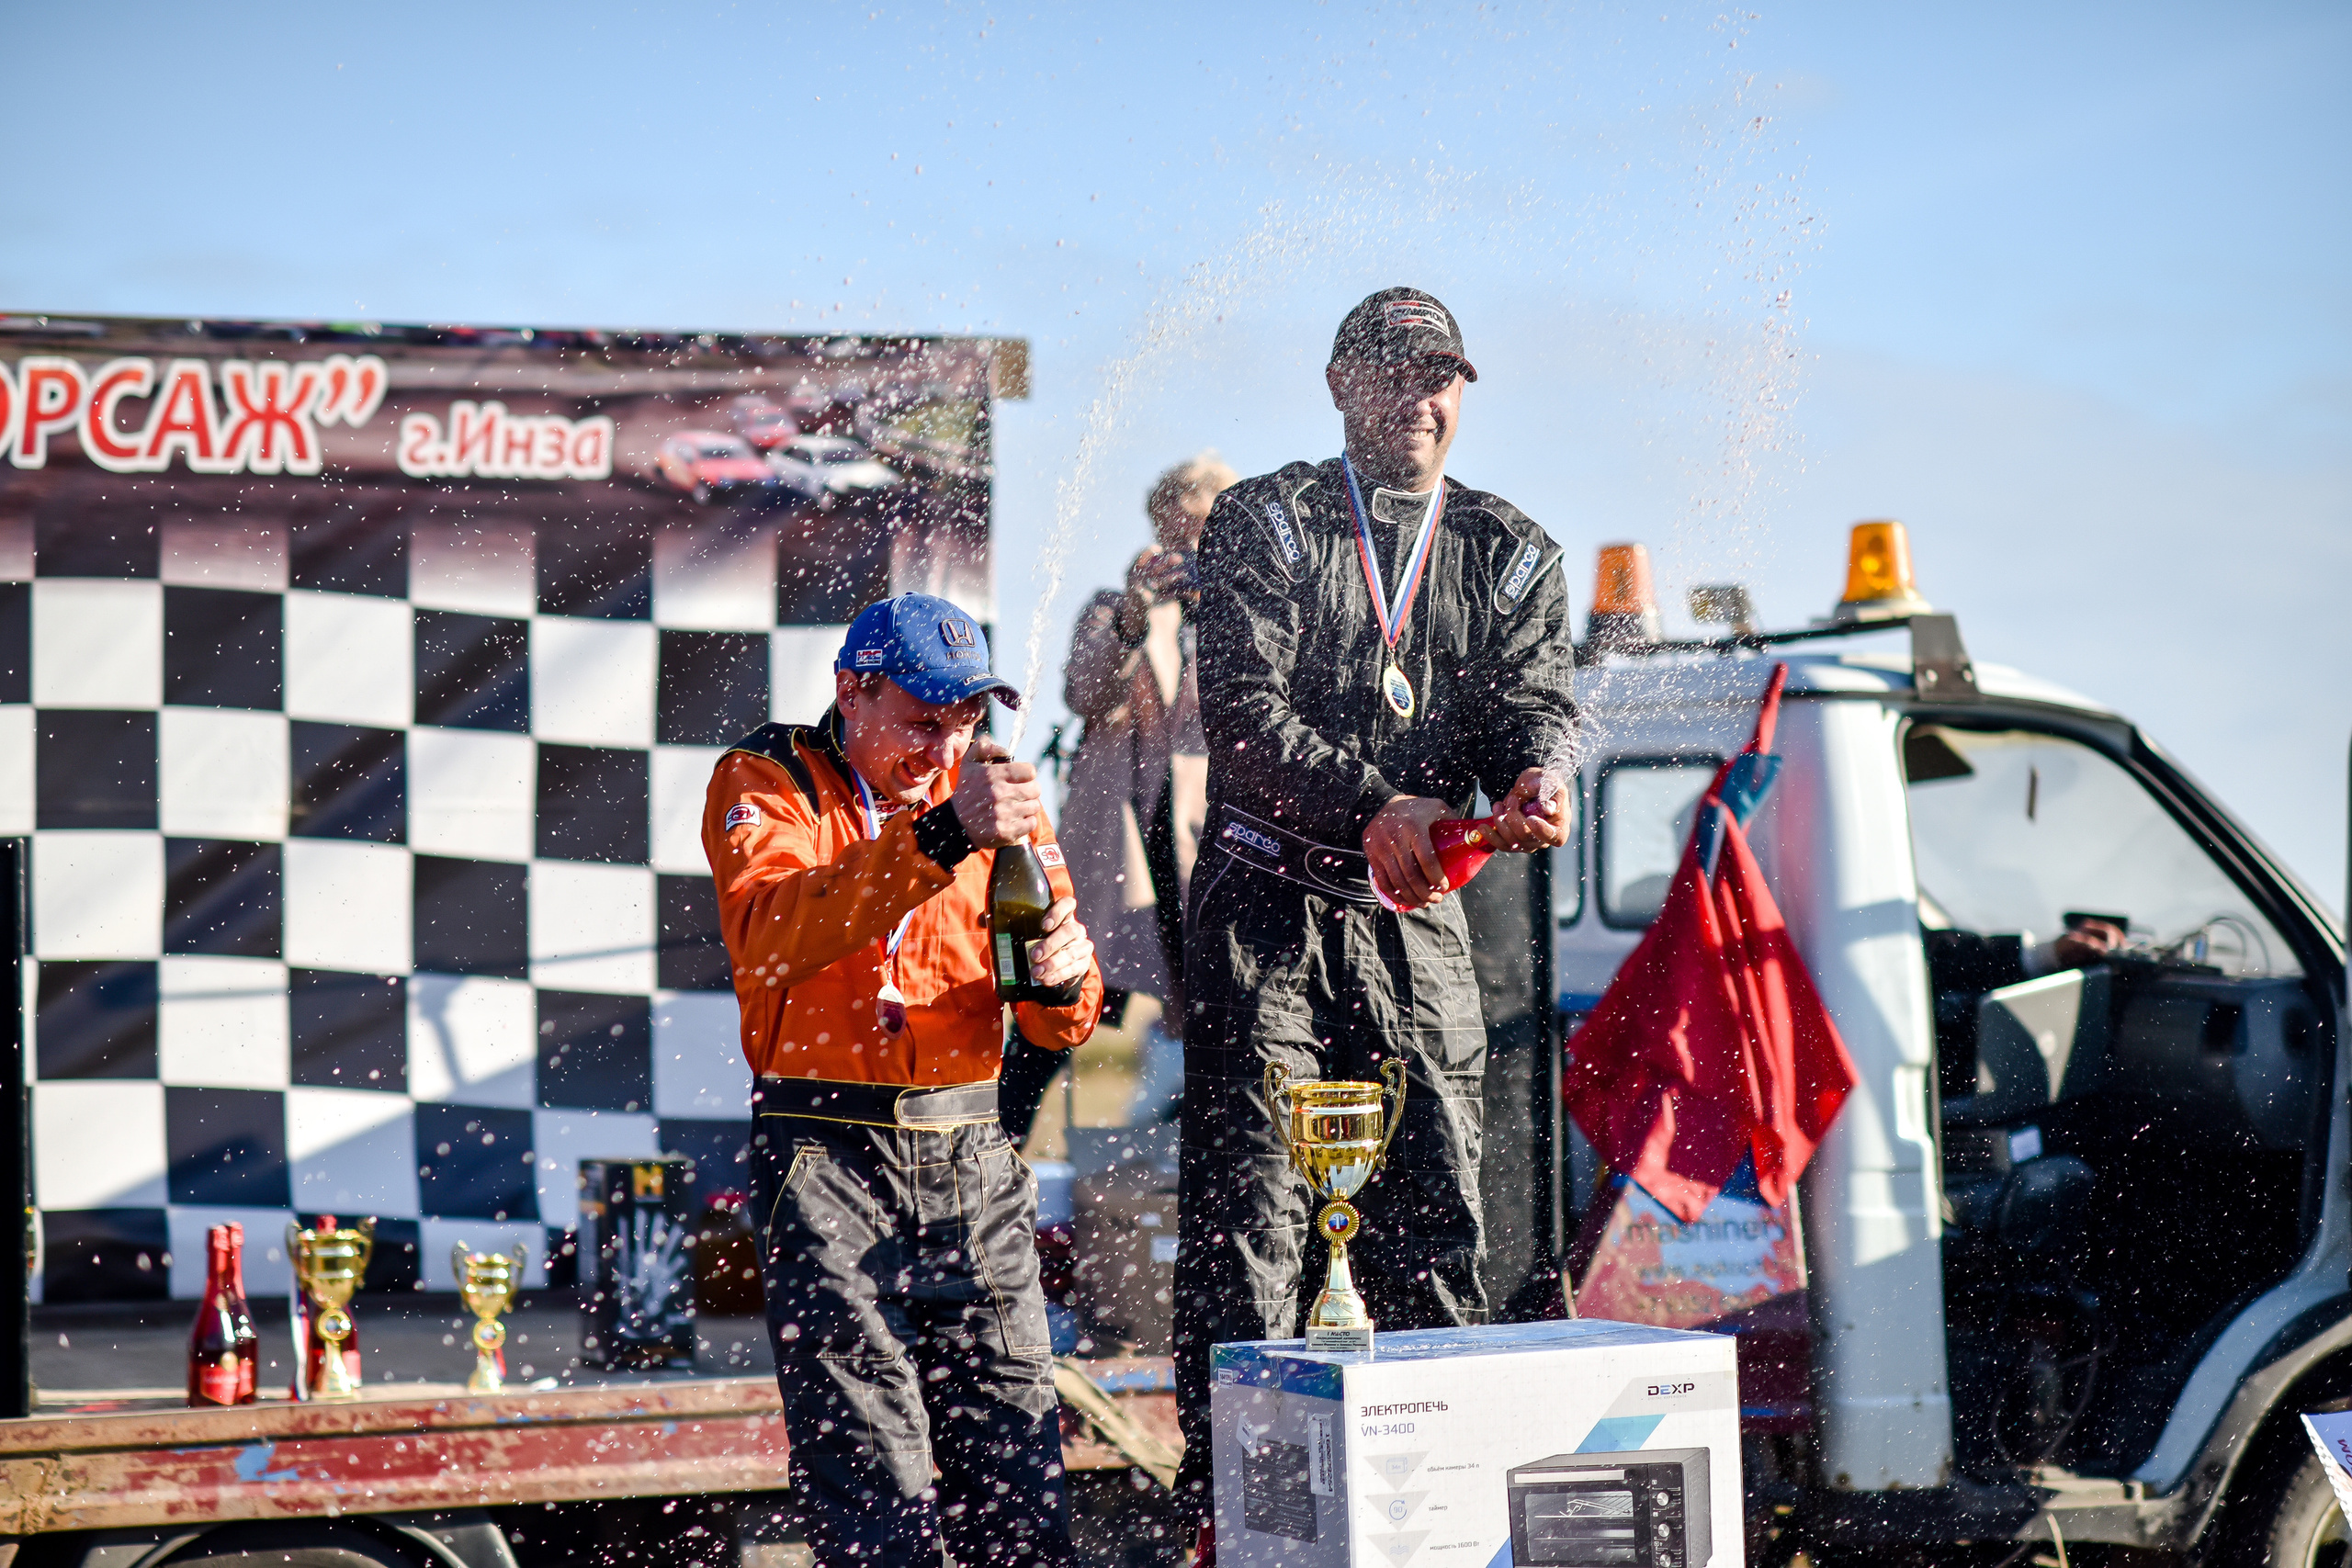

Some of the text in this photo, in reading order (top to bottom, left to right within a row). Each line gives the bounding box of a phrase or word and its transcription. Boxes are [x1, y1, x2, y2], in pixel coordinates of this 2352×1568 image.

[0, 355, 389, 474] РСАЖ”
[1265, 502, 1300, 563] sparco
[1504, 544, 1540, 599] sparco
[1228, 822, 1281, 857] sparco
[1647, 1382, 1695, 1396] DEXP
[1360, 1401, 1449, 1417] ЭЛЕКТРОПЕЧЬ
[1361, 1423, 1415, 1438] VN-3400
